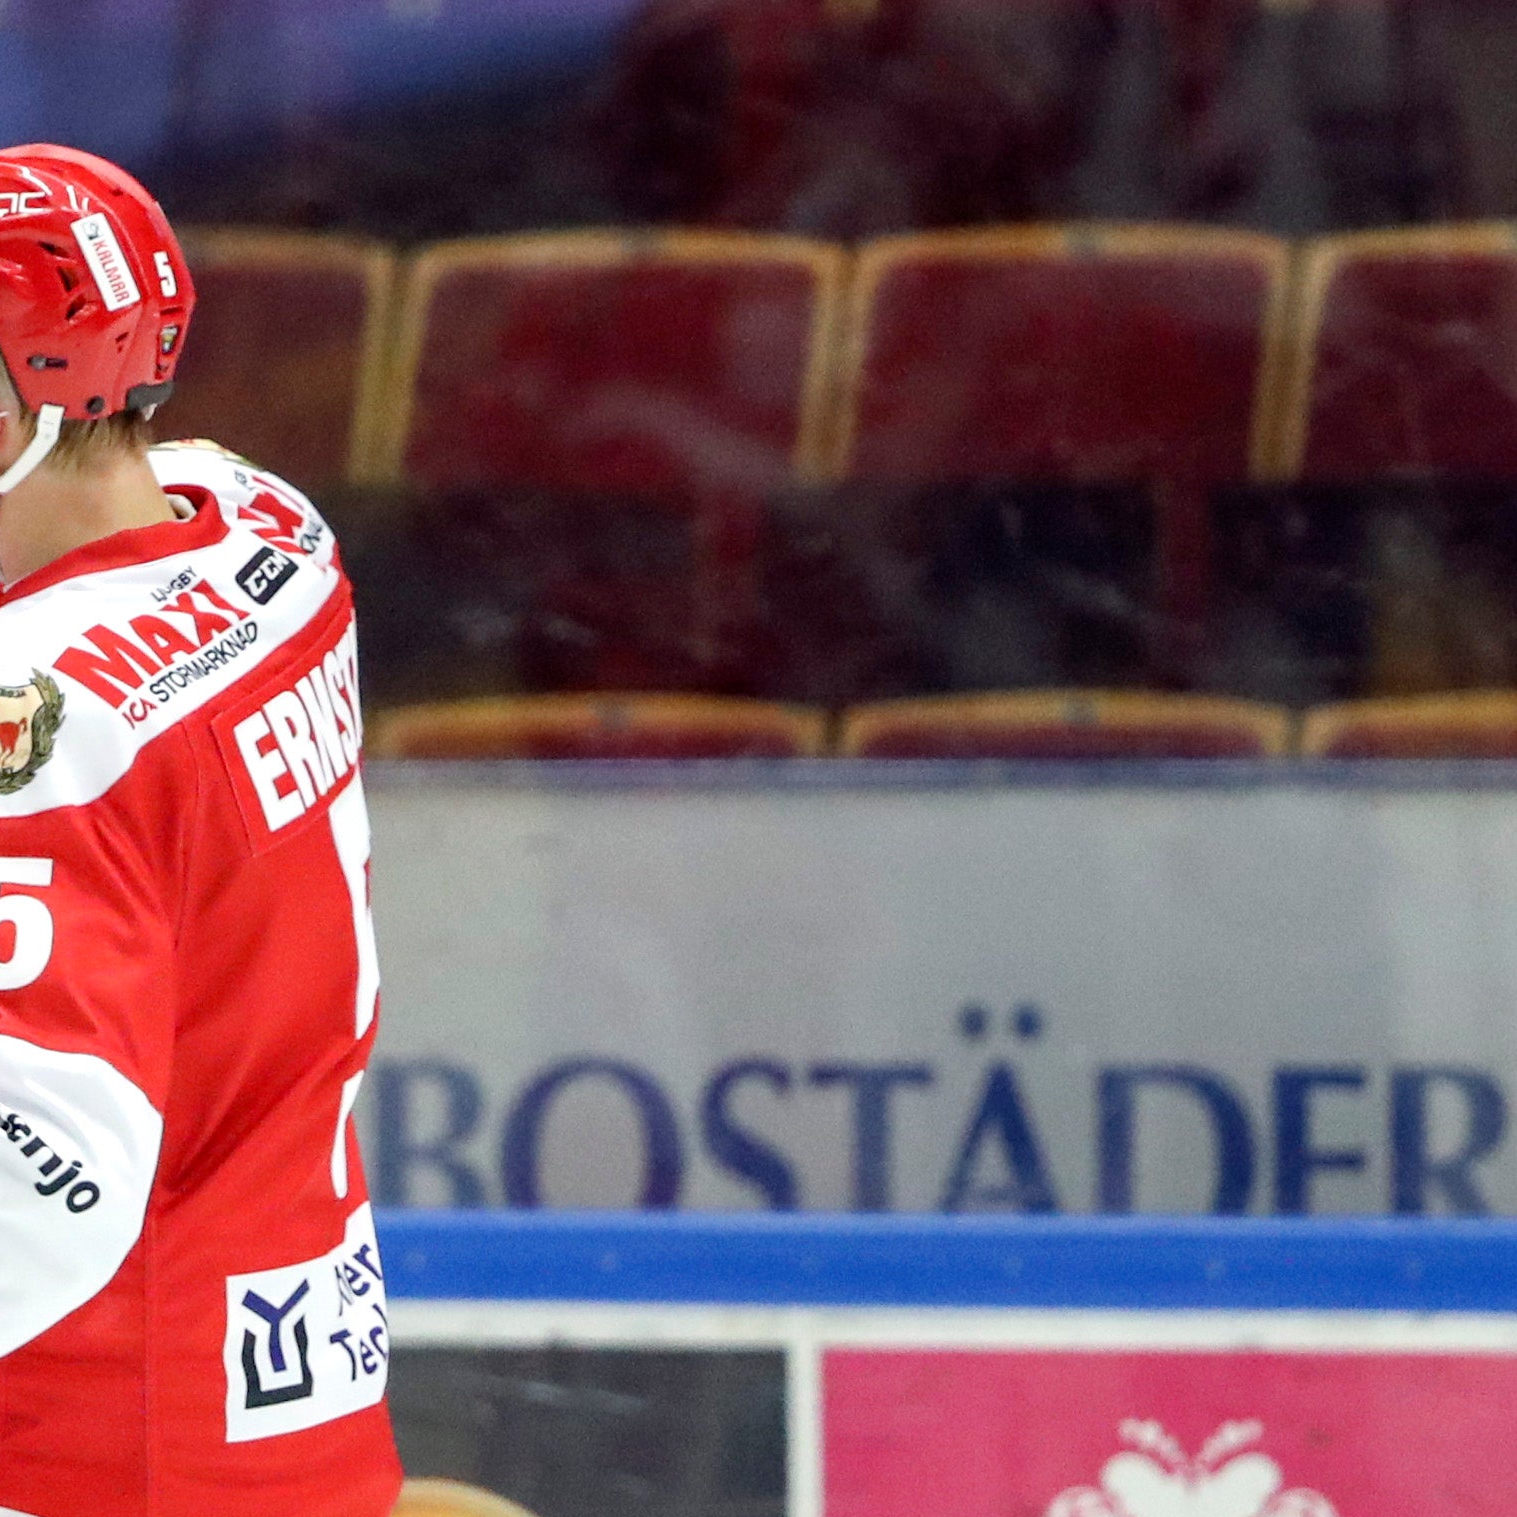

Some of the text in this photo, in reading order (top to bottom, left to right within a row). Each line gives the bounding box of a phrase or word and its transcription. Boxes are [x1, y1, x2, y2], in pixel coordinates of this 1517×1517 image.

[152, 250, 178, 298] 5
[241, 551, 293, 598] CCM
[52, 578, 252, 710] MAXI
[120, 620, 259, 731] ICA STORMARKNAD
